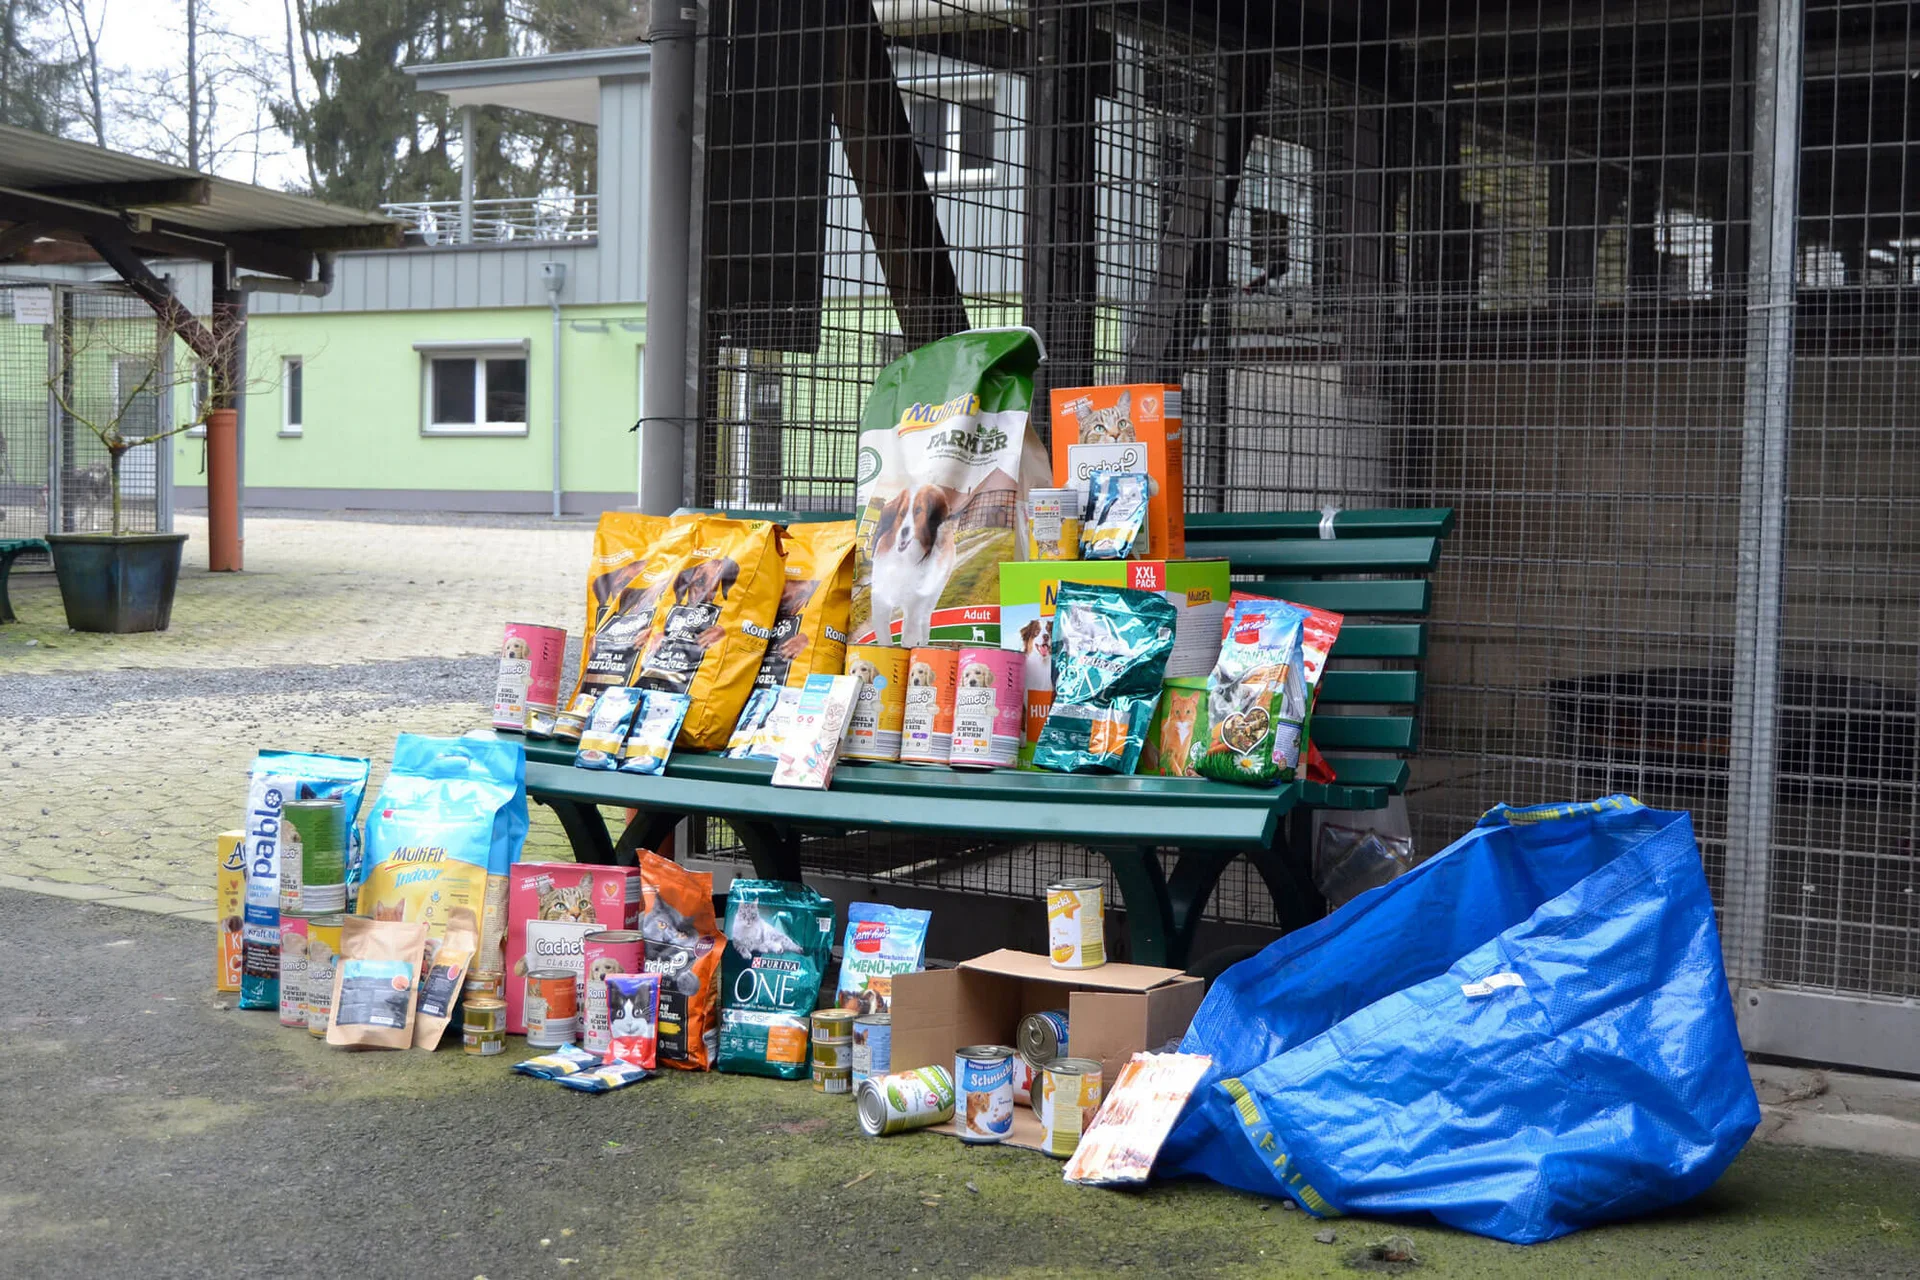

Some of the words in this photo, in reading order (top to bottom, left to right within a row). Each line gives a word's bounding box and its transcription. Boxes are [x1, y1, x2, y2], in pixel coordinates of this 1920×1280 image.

[906, 392, 976, 423] MultiFit
[926, 429, 1008, 454] FARMER
[1135, 566, 1156, 579] XXL
[1135, 579, 1157, 588] PACK
[963, 609, 991, 620] Adult
[741, 619, 771, 639] Rom
[825, 626, 847, 643] Rom
[252, 788, 283, 879] pablo
[392, 846, 446, 862] MultiFit
[394, 867, 444, 889] Indoor
[536, 936, 585, 956] Cachet
[546, 958, 584, 968] CLASSIC
[761, 959, 798, 971] PURINA
[848, 958, 912, 975] MENÜ-MIX
[588, 988, 607, 1000] Rom
[734, 967, 798, 1008] ONE
[970, 1060, 1014, 1087] Schnucki
